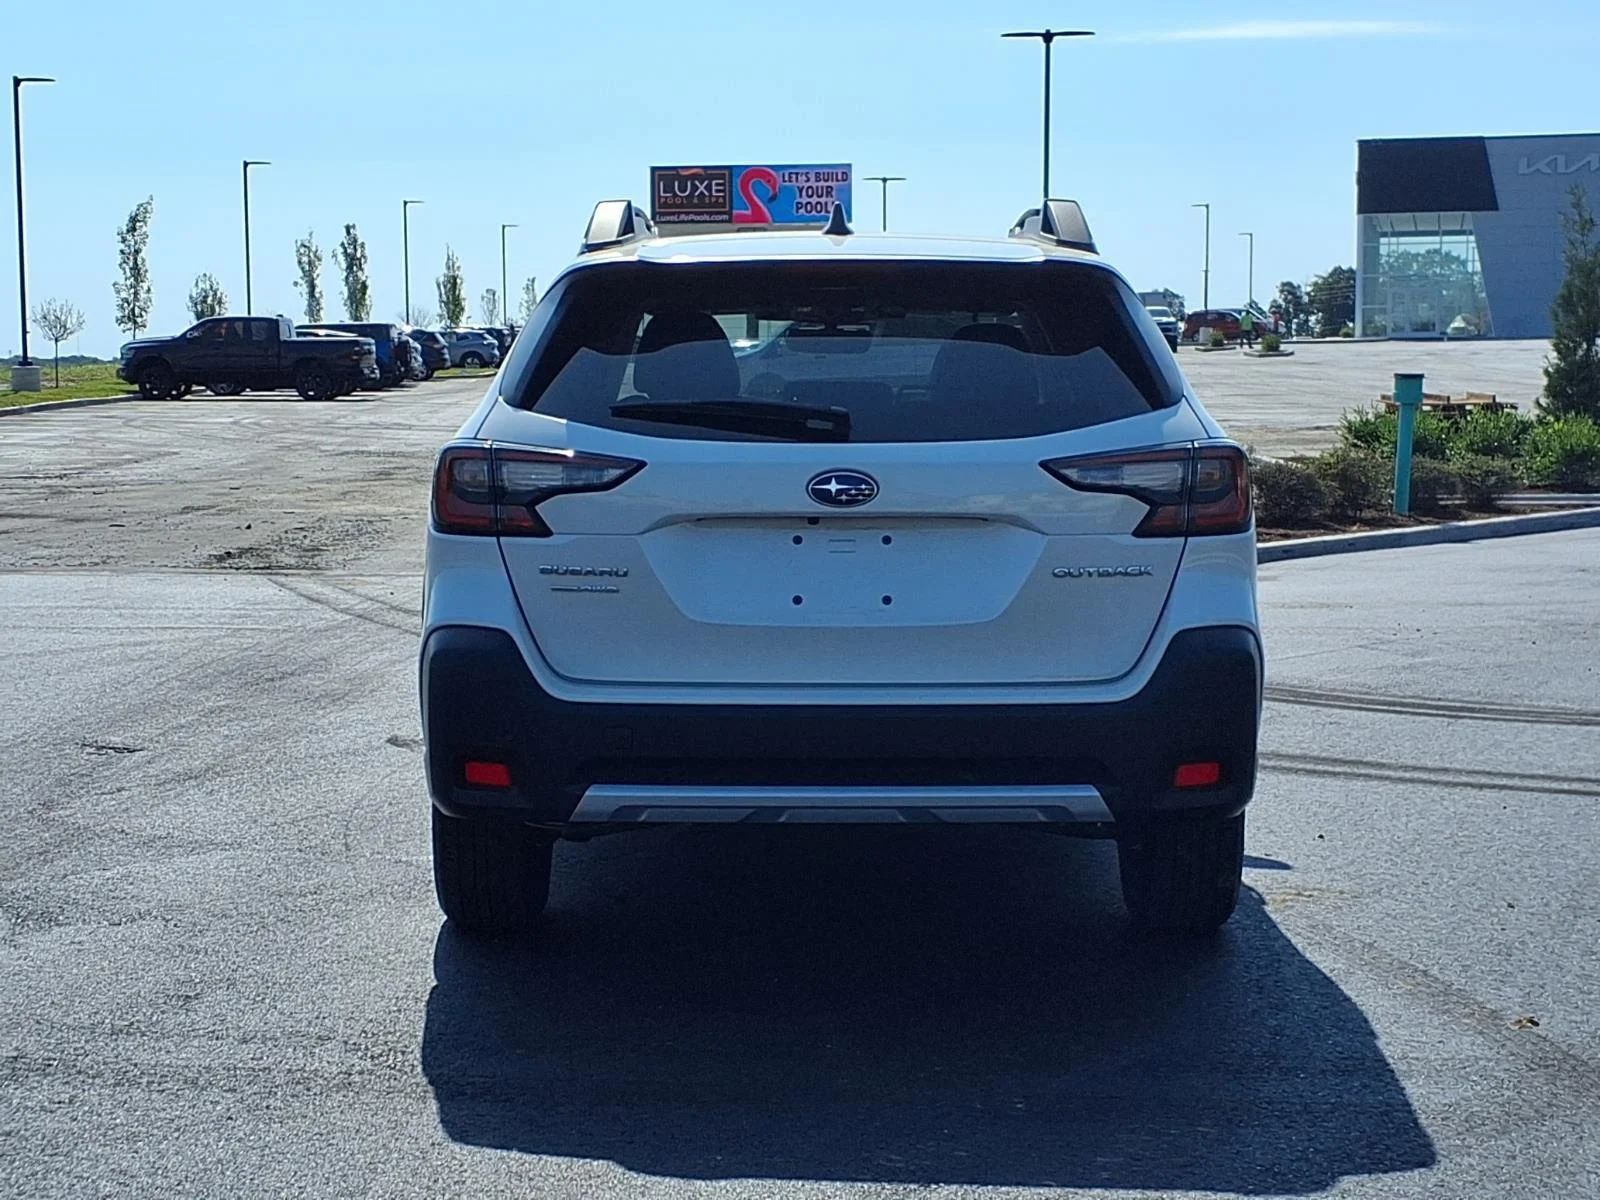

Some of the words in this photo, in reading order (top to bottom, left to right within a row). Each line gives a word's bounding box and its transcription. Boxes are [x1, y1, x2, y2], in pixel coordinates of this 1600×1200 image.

[782, 171, 810, 183] LET'S
[815, 171, 848, 183] BUILD
[659, 179, 725, 197] LUXE
[797, 185, 834, 199] YOUR
[795, 201, 835, 214] POOL
[539, 564, 629, 577] SUBARU
[1052, 565, 1154, 578] OUTBACK
